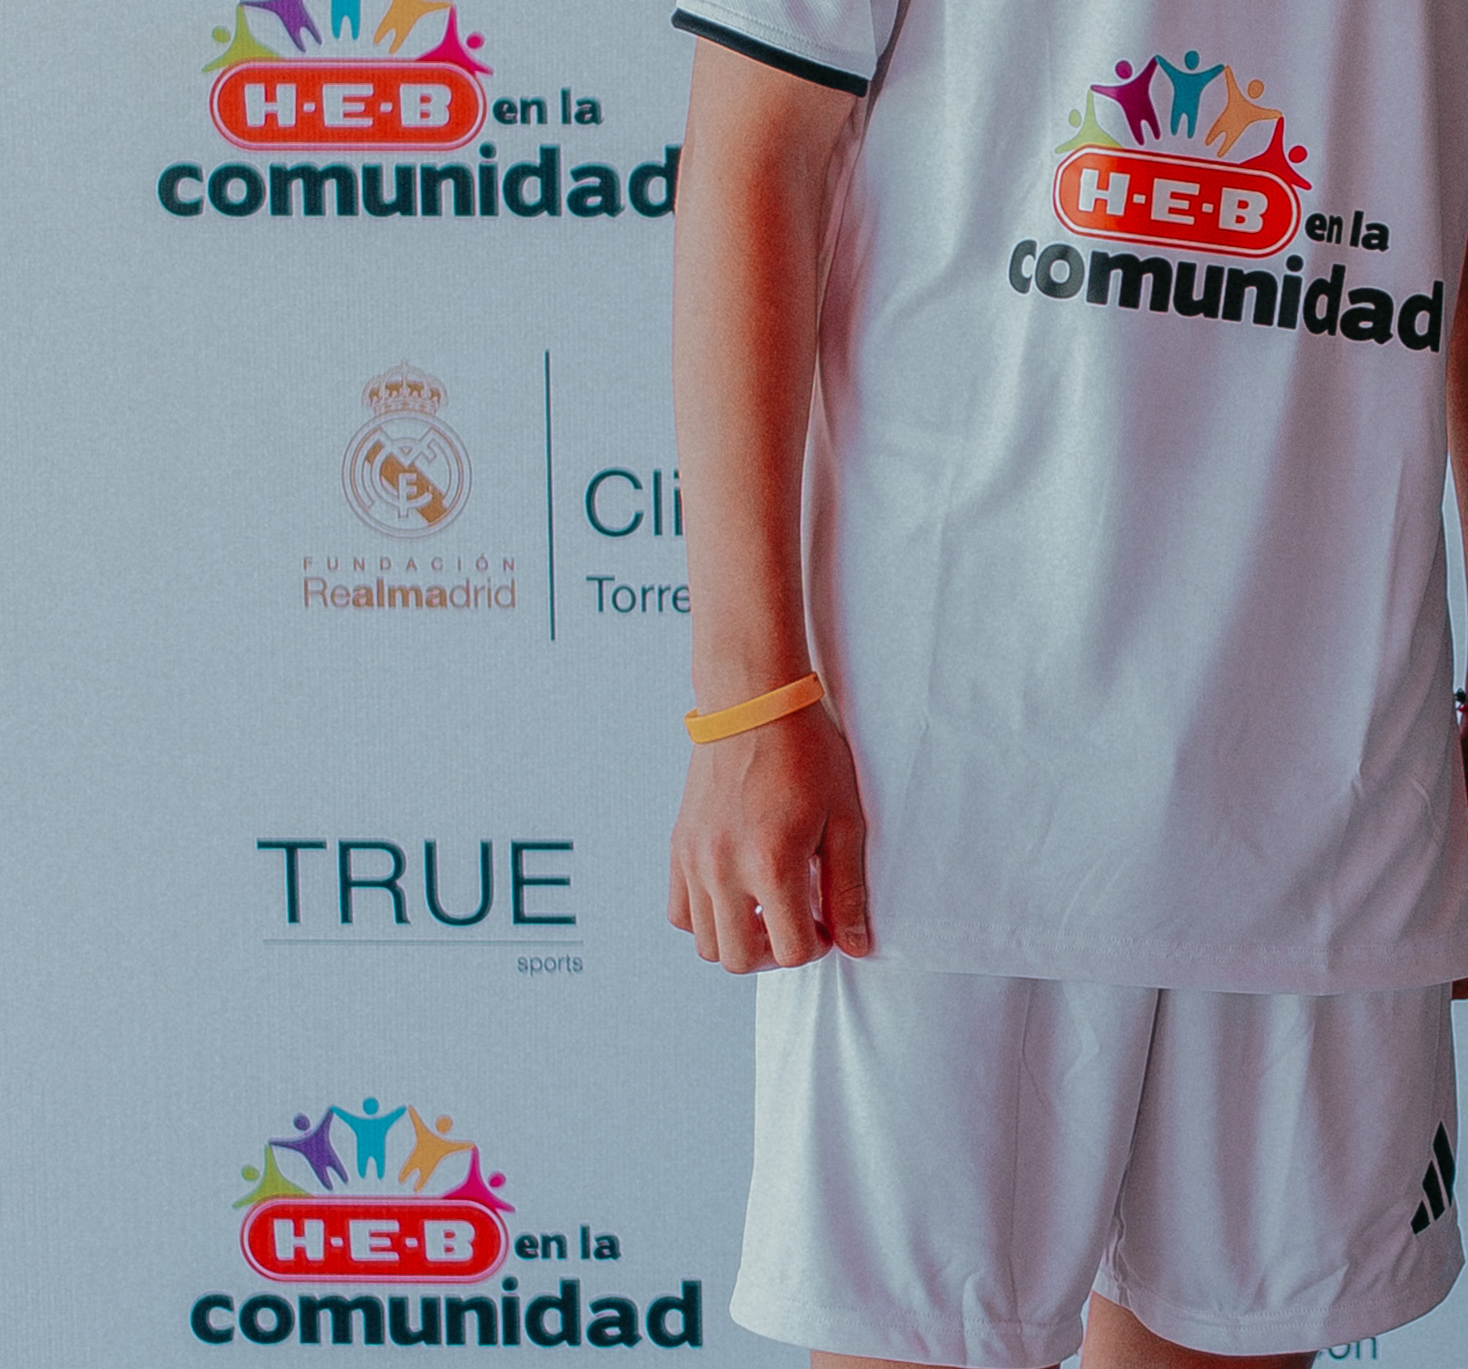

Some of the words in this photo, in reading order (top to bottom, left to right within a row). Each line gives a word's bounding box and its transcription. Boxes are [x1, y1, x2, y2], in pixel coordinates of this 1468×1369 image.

[492, 99, 548, 125] en
[561, 89, 603, 126] la
[158, 142, 683, 219] comunidad
[1304, 210, 1344, 248] en
[1349, 208, 1390, 252] la
[1007, 237, 1446, 354] comunidad
[584, 468, 683, 538] Cli
[303, 554, 515, 573] FUNDACIÓN
[303, 578, 516, 609] Realmadrid
[585, 575, 692, 614] Torre
[257, 840, 577, 927] TRUE
[517, 955, 584, 977] sports
[514, 1234, 567, 1260] en
[580, 1226, 621, 1261] la
[191, 1276, 703, 1348] comunidad
